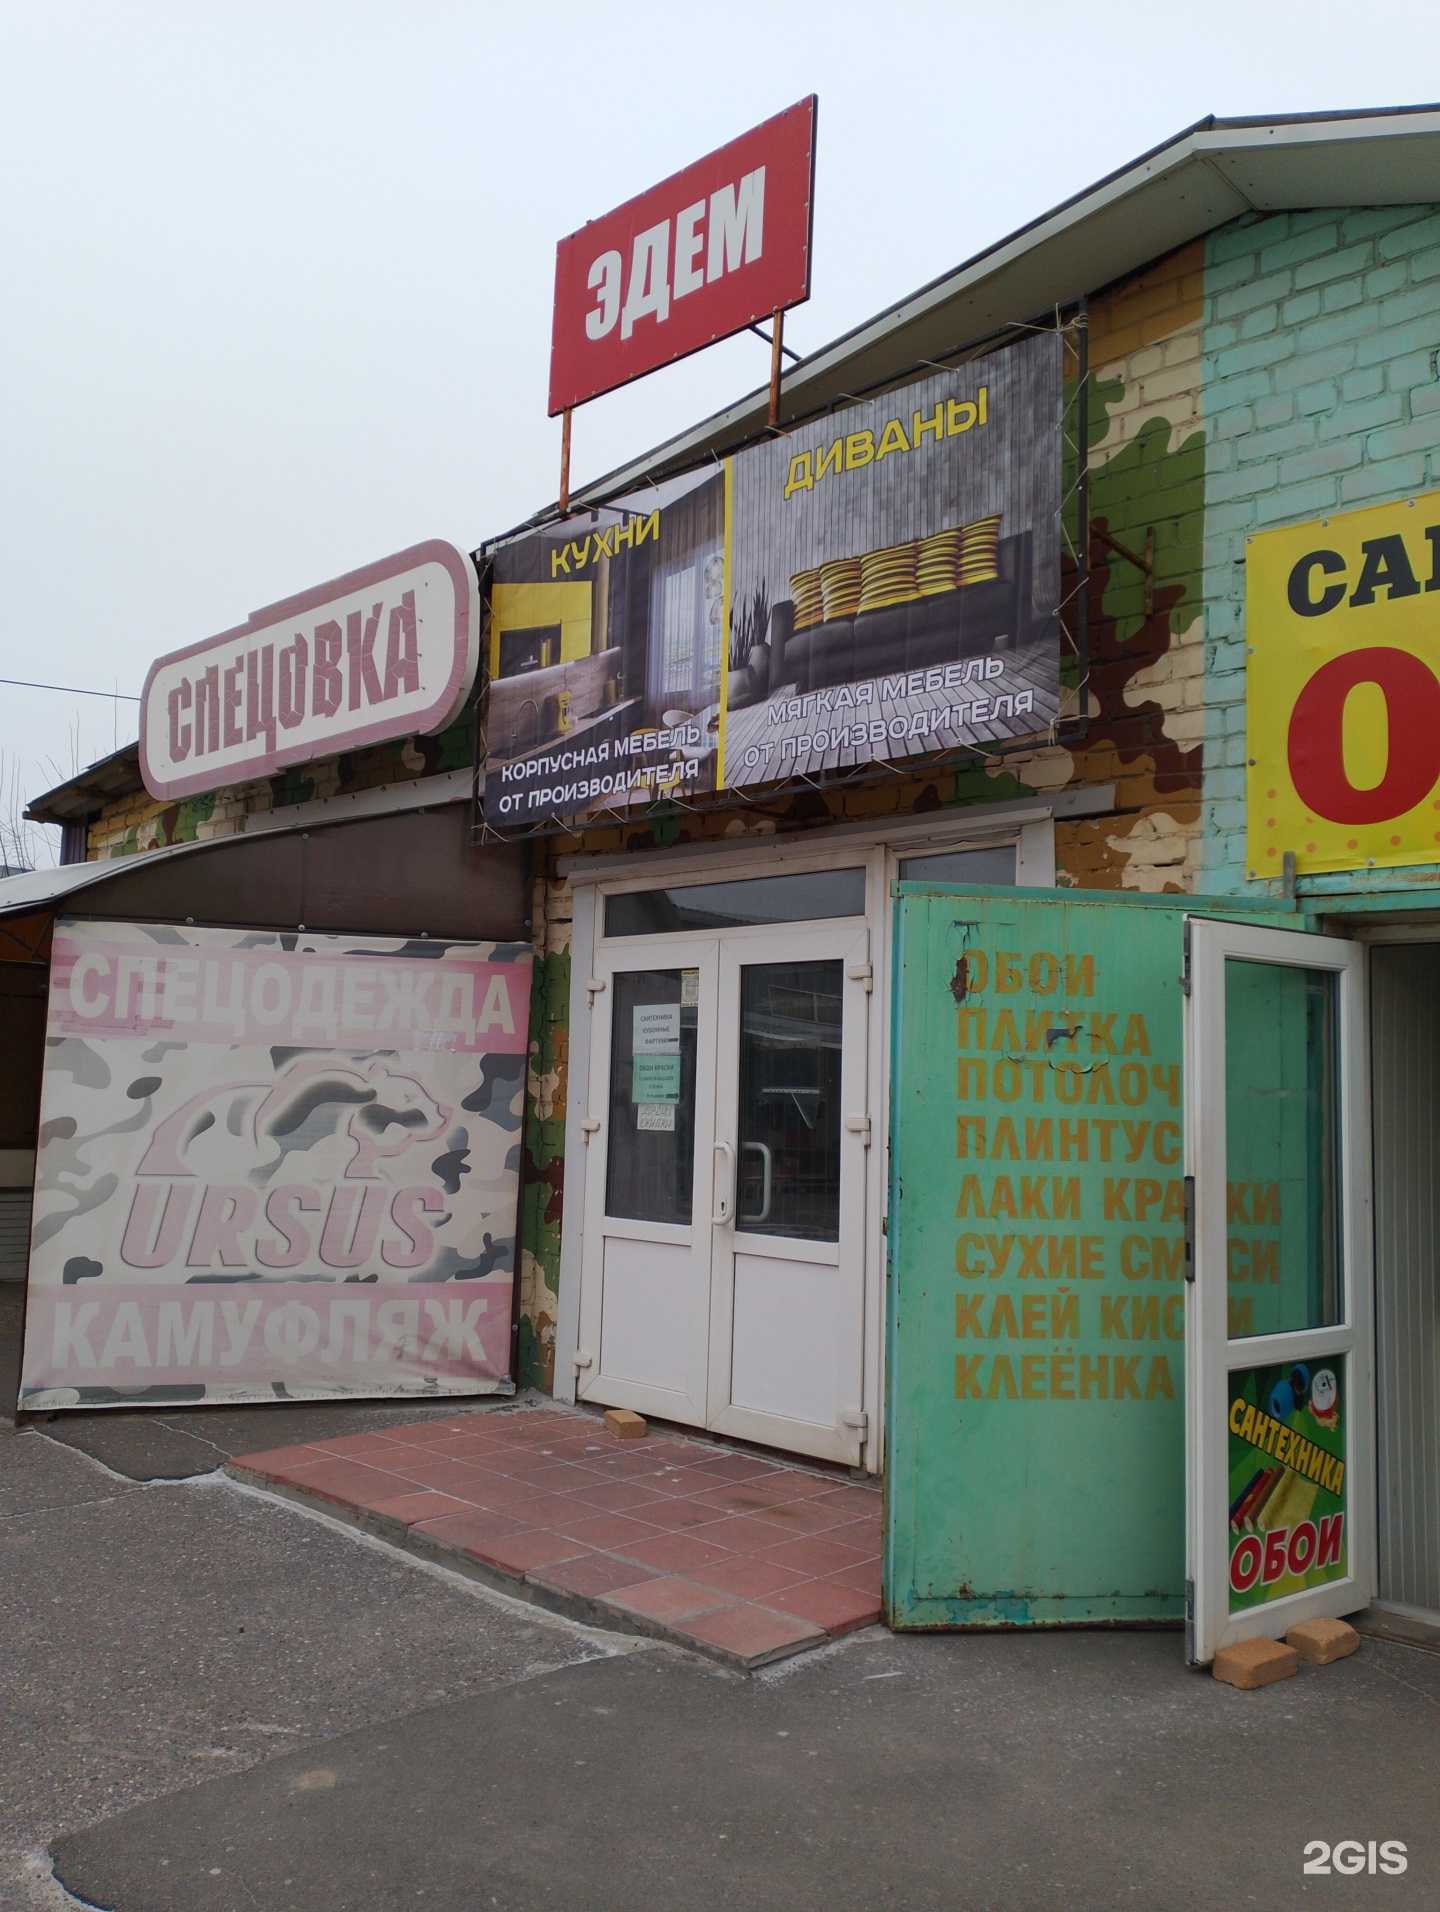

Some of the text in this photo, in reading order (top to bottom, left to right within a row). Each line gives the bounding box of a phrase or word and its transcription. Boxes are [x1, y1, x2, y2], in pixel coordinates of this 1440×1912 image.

[585, 165, 766, 341] ЭДЕМ
[784, 387, 989, 499] ДИВАНЫ
[551, 510, 661, 577] КУХНИ
[168, 589, 421, 753] СПЕЦОВКА
[767, 656, 1005, 726] МЯГКАЯ МЕБЕЛЬ
[501, 725, 700, 783] КОРПУСНАЯ МЕБЕЛЬ
[743, 689, 1035, 768] ОТ ПРОИЗВОДИТЕЛЯ
[498, 758, 700, 813] ОТ ПРОИЗВОДИТЕЛЯ
[69, 953, 514, 1045] СПЕЦОДЕЖДА
[958, 948, 1096, 998] ОБОИ
[957, 1007, 1152, 1057] ПЛИТКА
[957, 1056, 1182, 1109] ПОТОЛОЧ
[956, 1115, 1184, 1165] ПЛИНТУС
[120, 1183, 445, 1269] URSUS
[955, 1174, 1281, 1226] ЛАКИ КРАКИ
[955, 1231, 1280, 1285] СУХИЕ СМСИ
[51, 1298, 489, 1369] КАМУФЛЯЖ
[954, 1286, 1253, 1341] КЛЕЙ КИСИ
[953, 1346, 1176, 1401] КЛЕЁНКА
[1228, 1397, 1345, 1496] САНТЕХНИКА
[1229, 1512, 1345, 1594] ОБОИ
